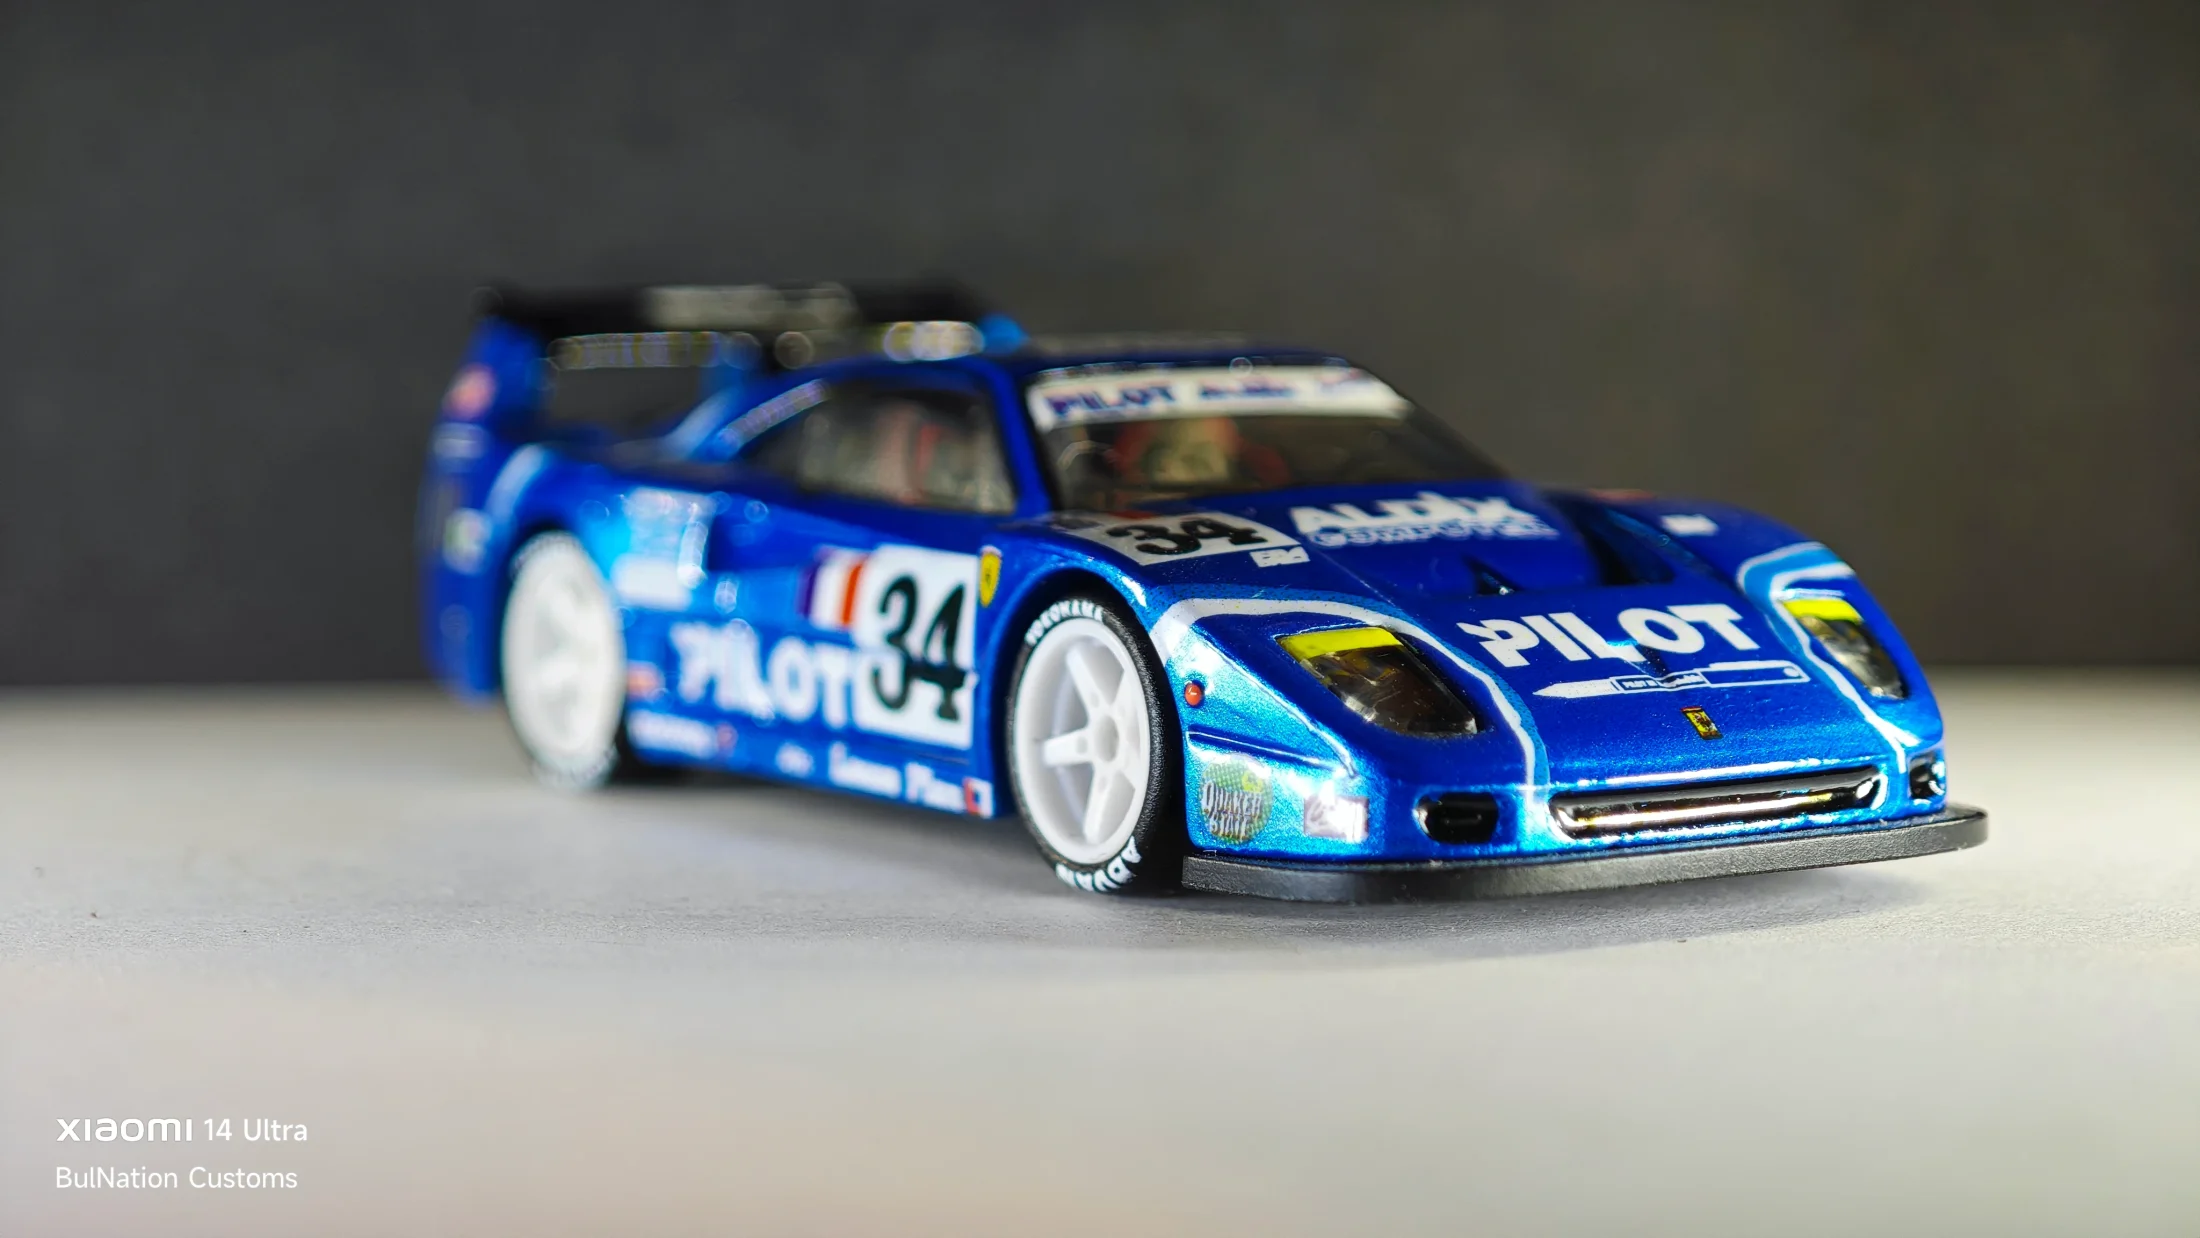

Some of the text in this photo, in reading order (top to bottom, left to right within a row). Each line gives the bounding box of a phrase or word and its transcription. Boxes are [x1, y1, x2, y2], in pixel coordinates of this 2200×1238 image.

[1106, 517, 1268, 555] 34
[872, 575, 968, 720] 34
[1025, 600, 1103, 647] YOKOHAMA
[1458, 604, 1760, 669] PILOT
[671, 619, 855, 730] PILOT
[1201, 780, 1264, 818] QUAKER
[1056, 836, 1142, 892] ADVAN
